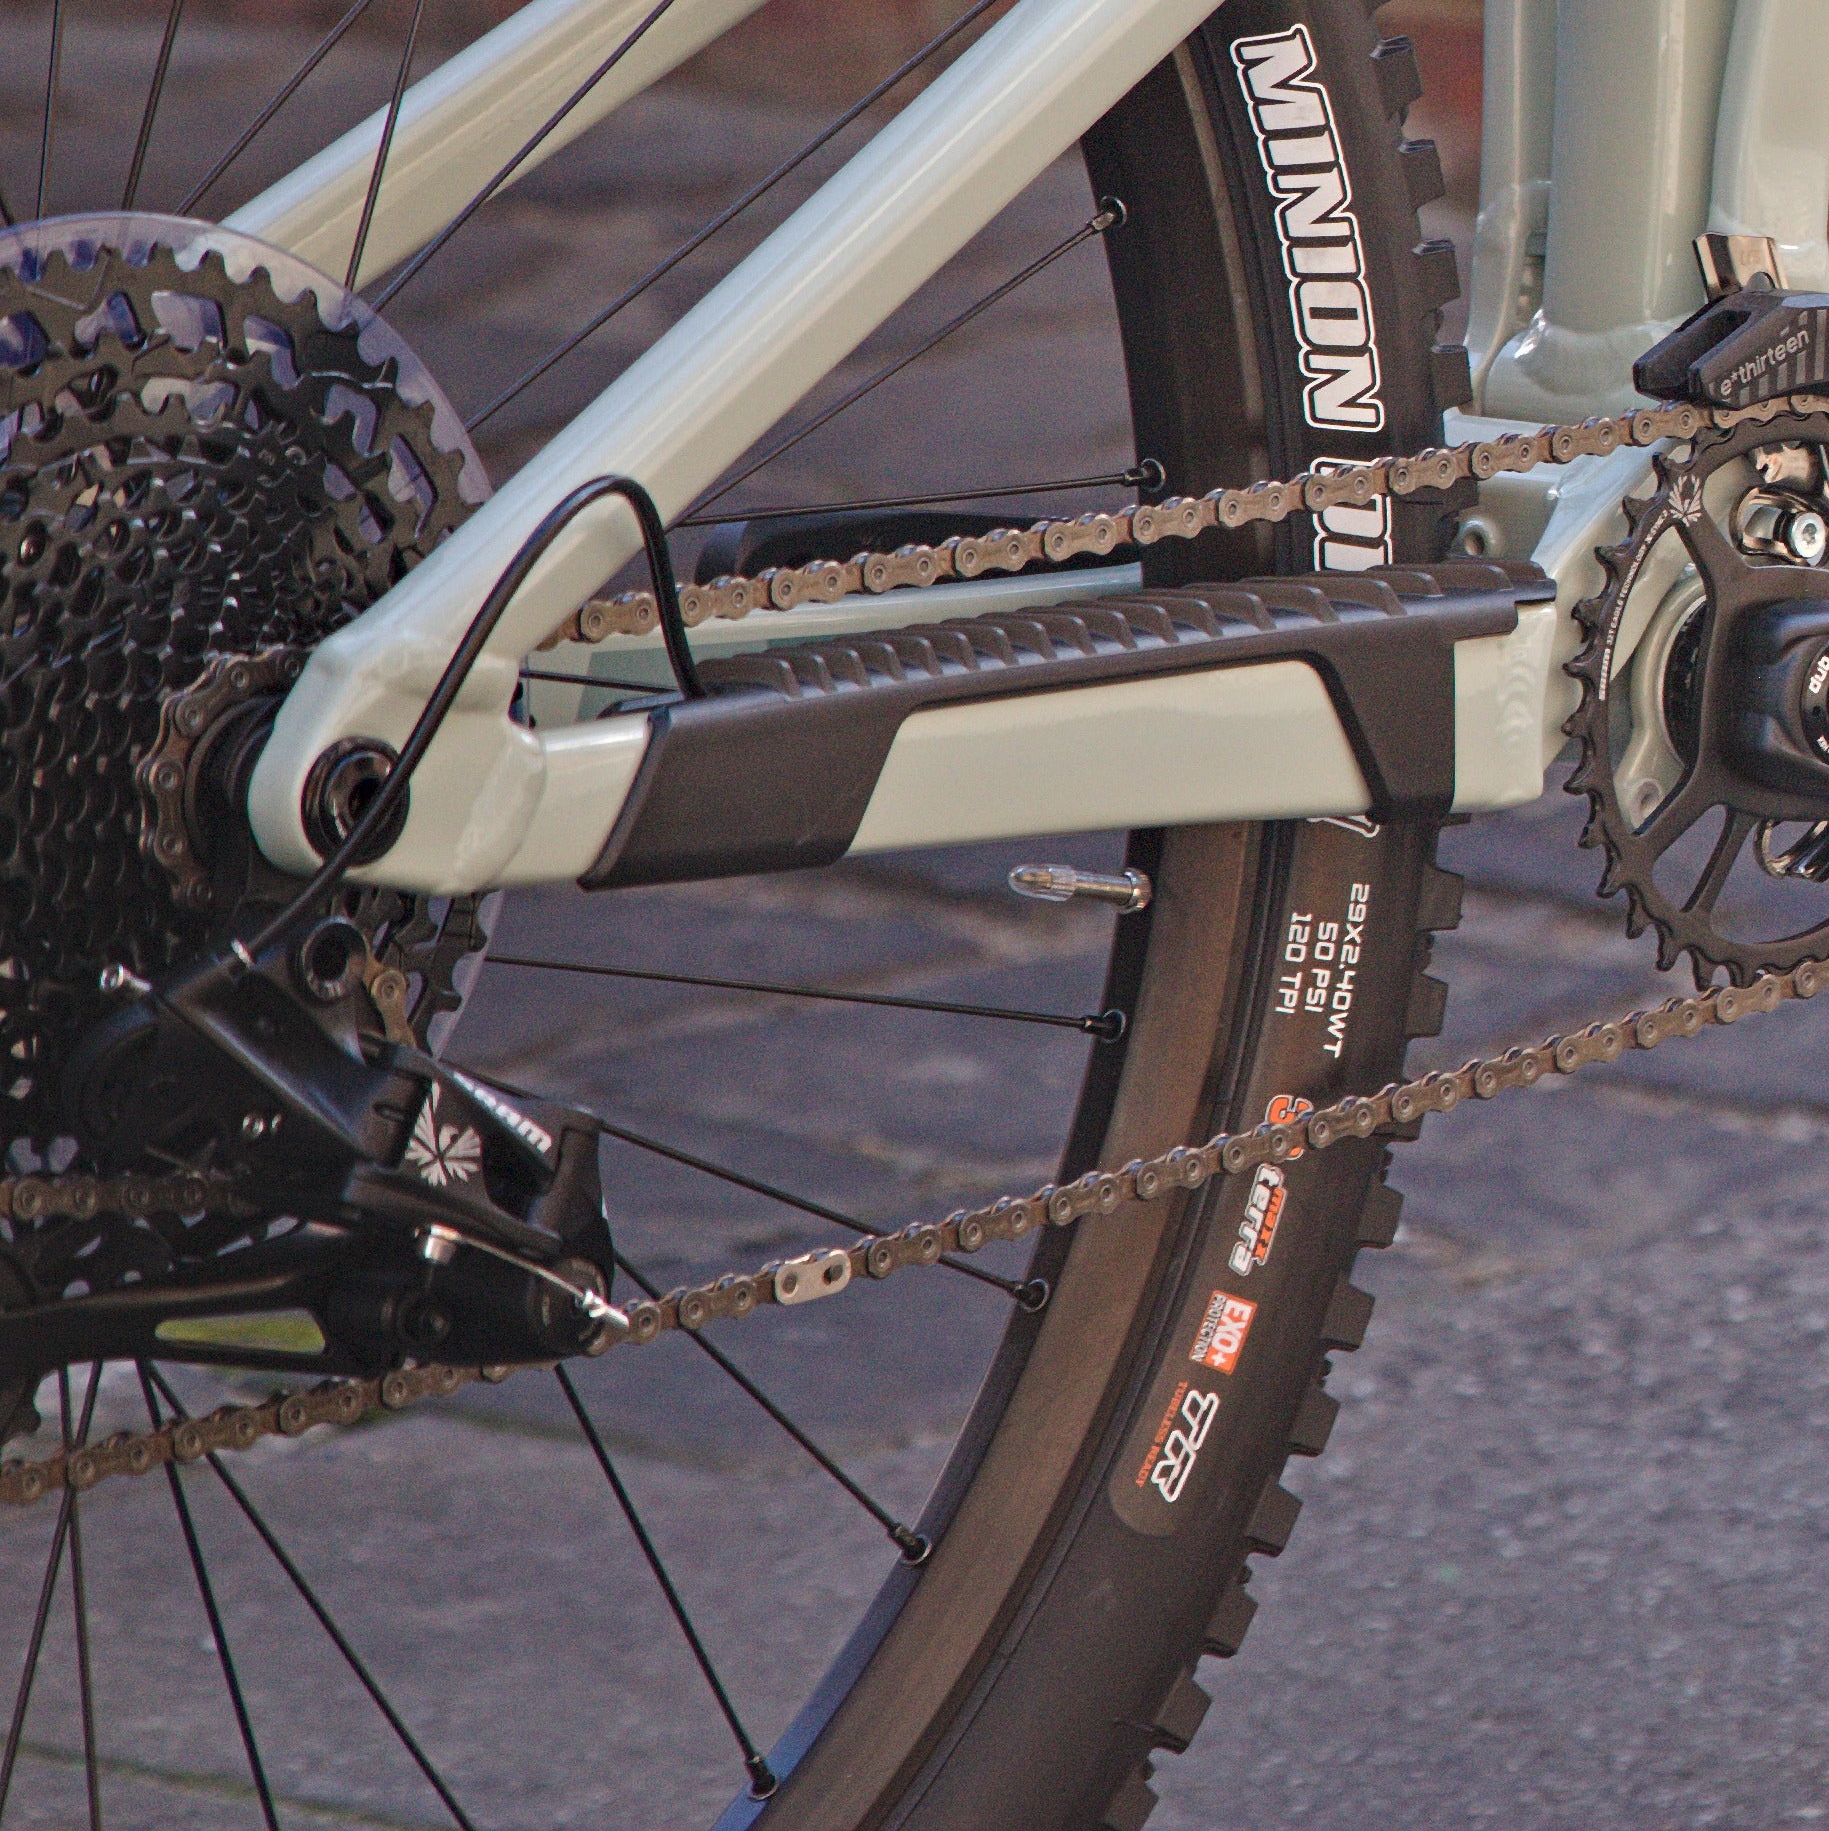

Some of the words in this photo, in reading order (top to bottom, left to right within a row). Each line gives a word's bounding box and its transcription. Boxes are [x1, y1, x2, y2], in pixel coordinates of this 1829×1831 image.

[1231, 24, 1385, 431] MINION
[1285, 912, 1312, 963] 120
[1314, 921, 1339, 962] 50
[1275, 971, 1303, 1013] TPI
[1304, 968, 1331, 1012] PSI
[1323, 883, 1370, 1058] 29X2.40WT
[1211, 1298, 1253, 1367] EXO+
